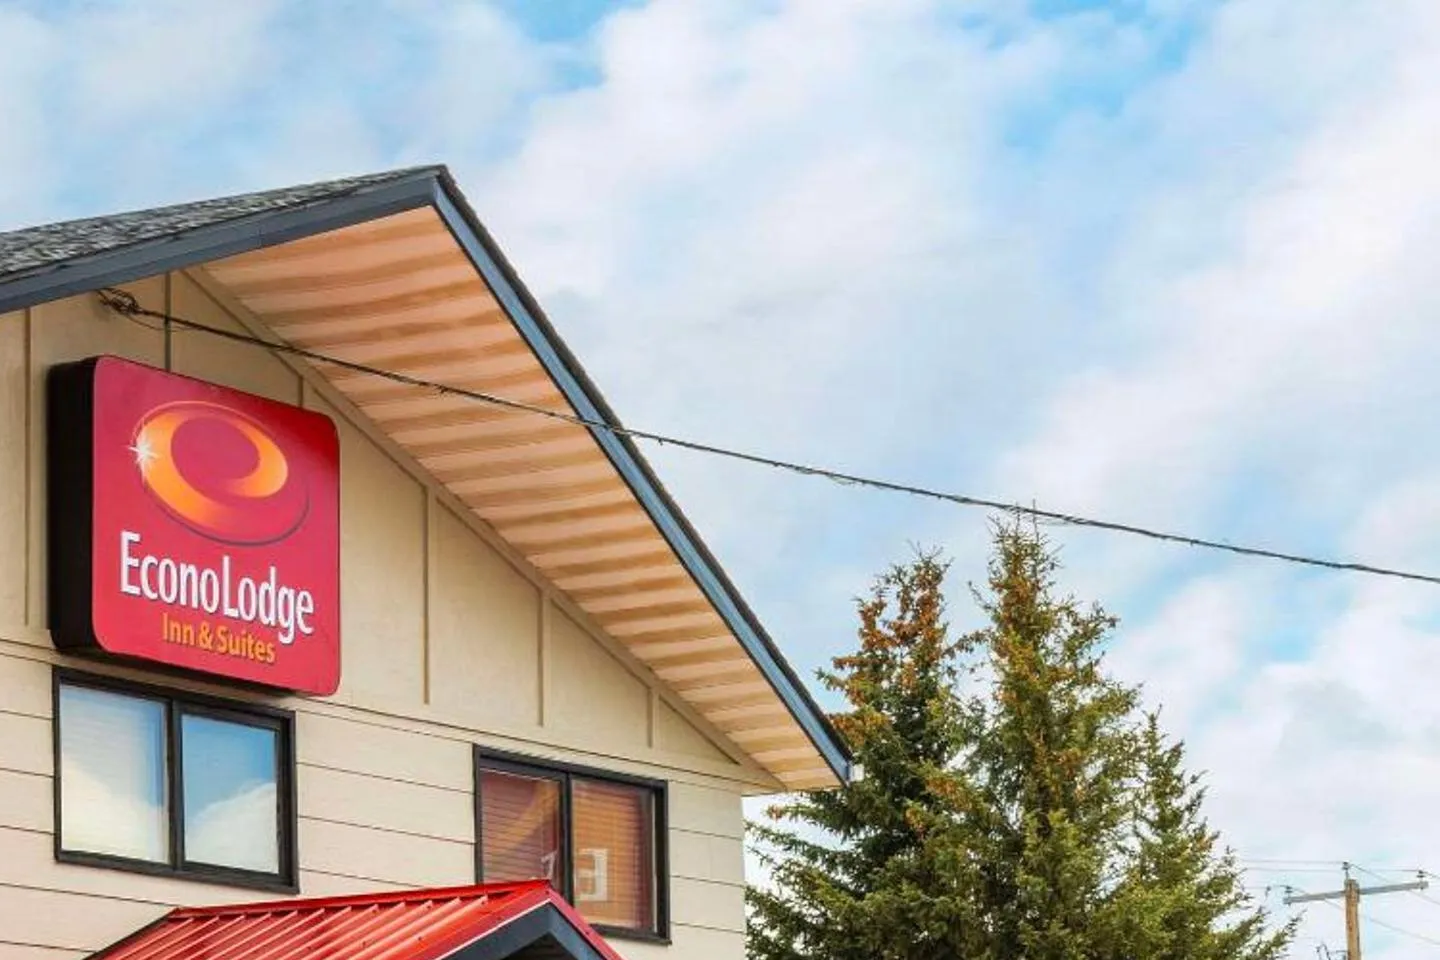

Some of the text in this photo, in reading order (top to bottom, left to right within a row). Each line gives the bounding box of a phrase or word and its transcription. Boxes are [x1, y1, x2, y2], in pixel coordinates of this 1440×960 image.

[120, 530, 315, 645] EconoLodge
[162, 612, 276, 664] Inn & Suites
